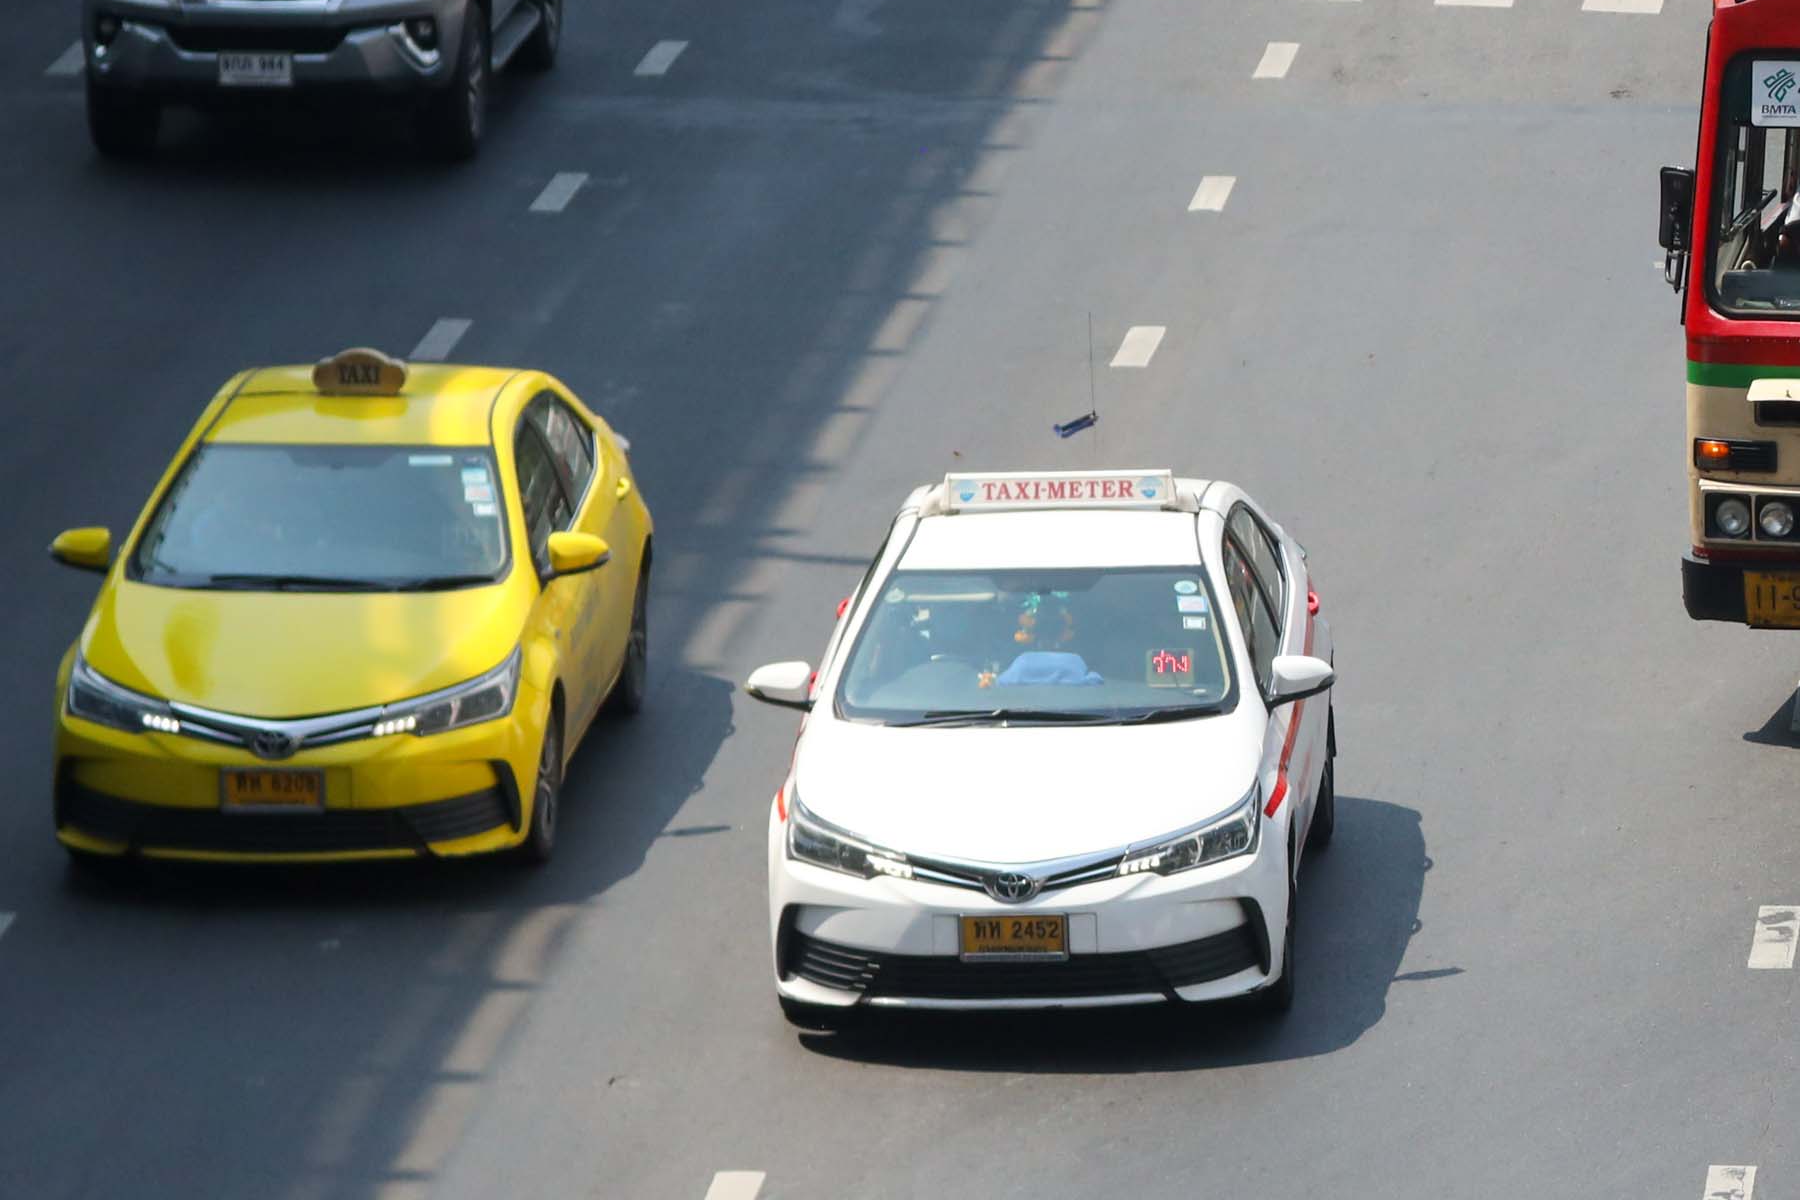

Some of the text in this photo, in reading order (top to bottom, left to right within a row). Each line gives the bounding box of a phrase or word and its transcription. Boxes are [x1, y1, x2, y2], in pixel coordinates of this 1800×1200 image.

[1760, 103, 1797, 115] BMTA
[338, 365, 381, 385] TAXI
[981, 479, 1134, 501] TAXI-METER
[1152, 649, 1190, 673] ว่าง
[1011, 920, 1060, 939] 2452
